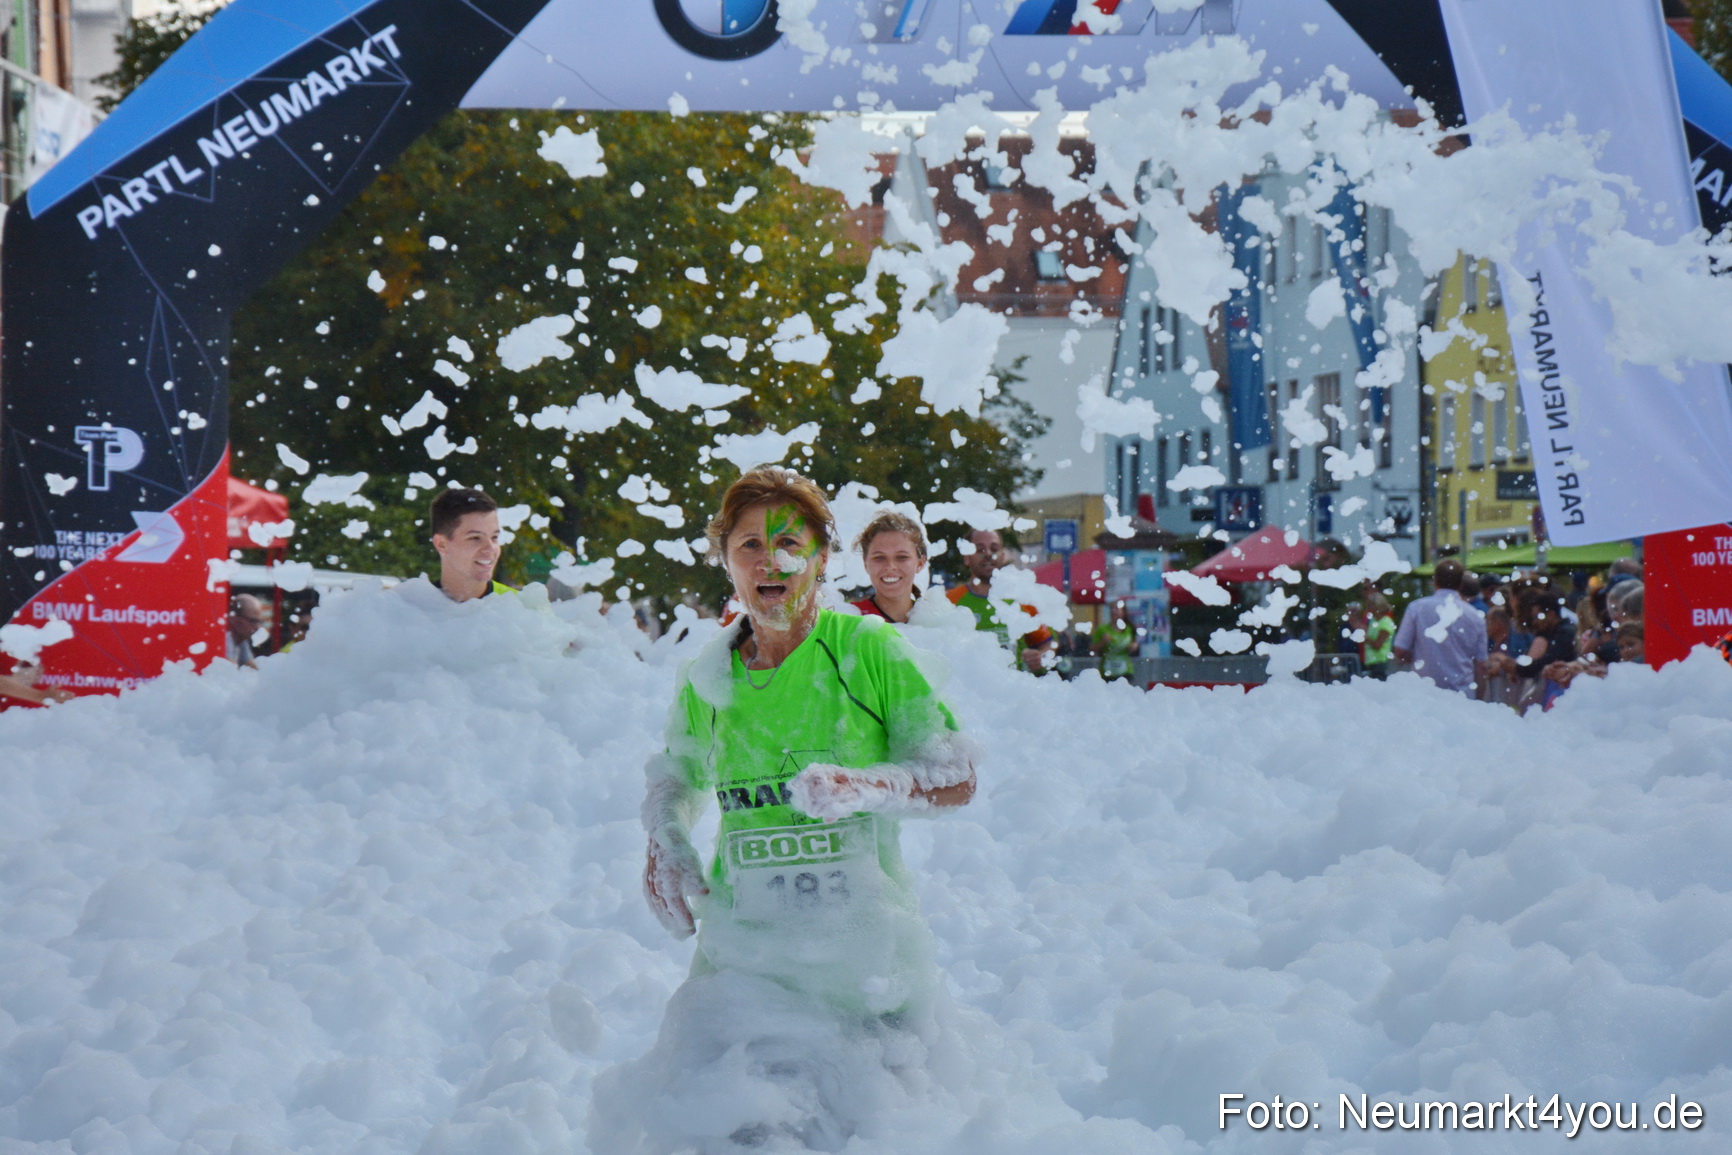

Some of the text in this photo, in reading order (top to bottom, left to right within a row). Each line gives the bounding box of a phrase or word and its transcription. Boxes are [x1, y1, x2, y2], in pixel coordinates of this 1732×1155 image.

[76, 24, 402, 240] PARTL NEUMARKT
[54, 530, 125, 545] THE NEXT
[34, 545, 107, 561] 100 YEARS
[1692, 552, 1715, 566] 100
[33, 602, 185, 627] BMW Laufsport
